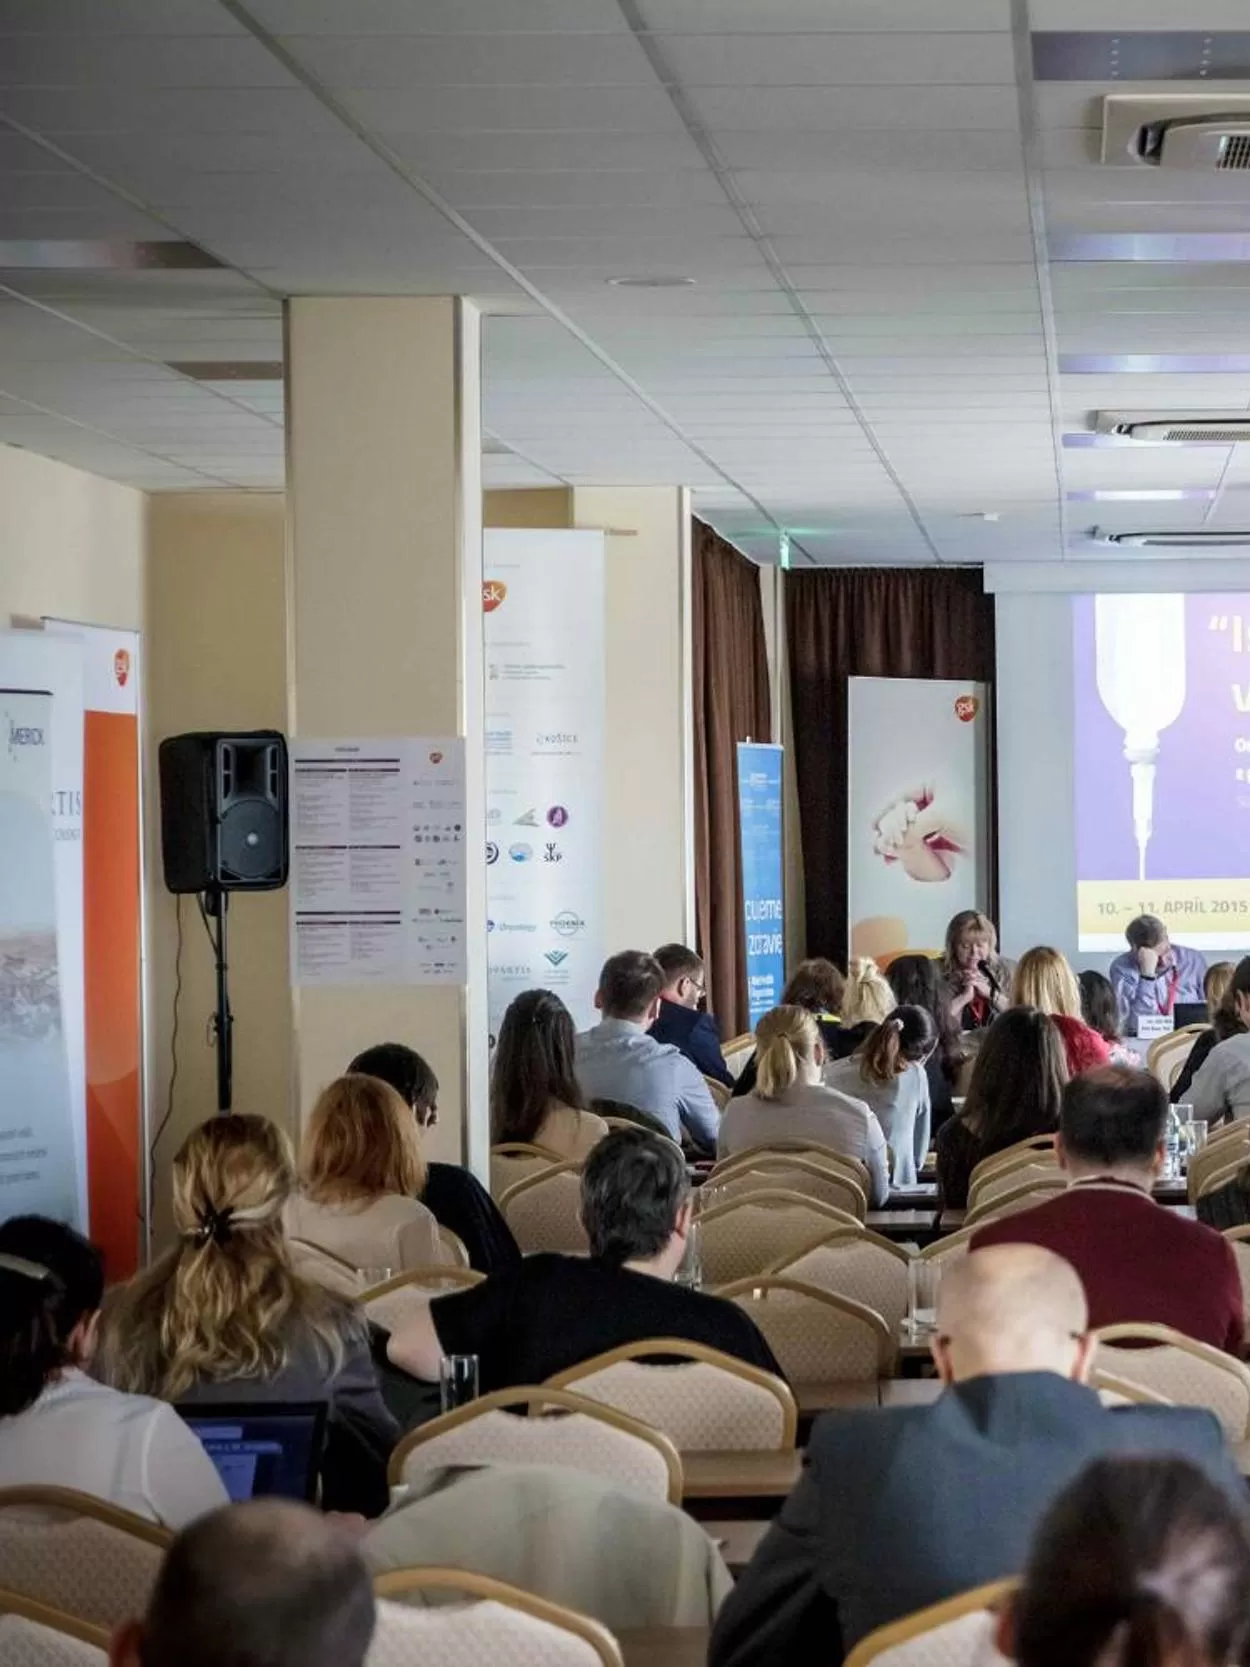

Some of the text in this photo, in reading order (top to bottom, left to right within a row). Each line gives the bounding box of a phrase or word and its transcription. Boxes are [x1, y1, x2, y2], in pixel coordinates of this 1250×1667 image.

[1098, 901, 1120, 915] 10.
[1164, 896, 1206, 913] APRÍL
[1211, 900, 1249, 914] 2015
